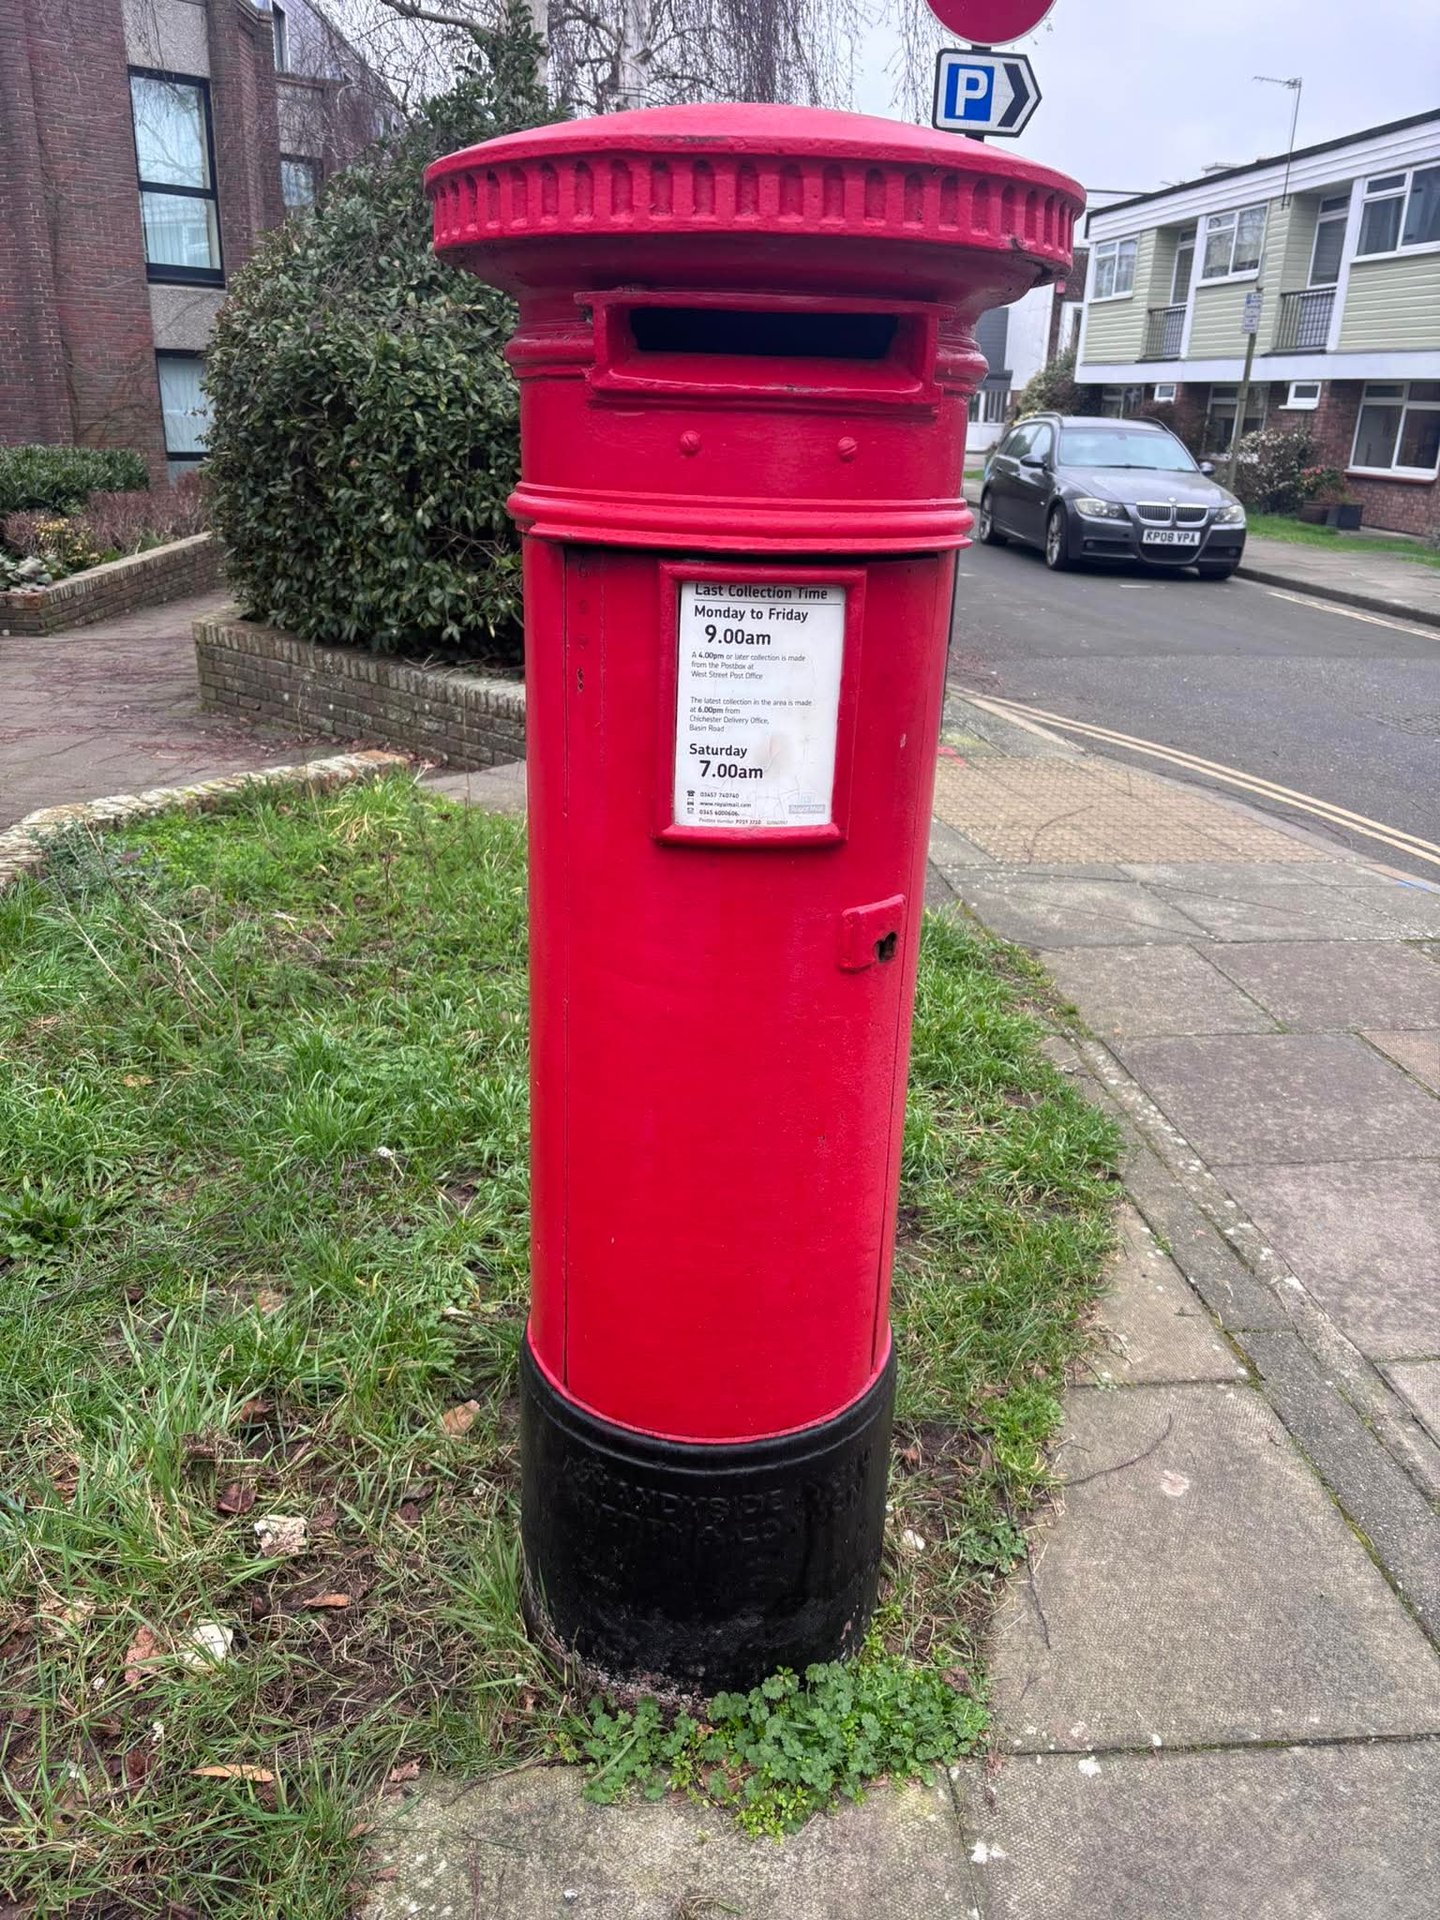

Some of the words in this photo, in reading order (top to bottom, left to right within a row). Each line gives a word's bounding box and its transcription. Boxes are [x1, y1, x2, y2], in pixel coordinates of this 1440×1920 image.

[955, 68, 989, 117] P
[1146, 531, 1174, 543] KP08
[1177, 532, 1196, 543] VPA
[695, 583, 724, 596] Last
[728, 585, 792, 599] Collection
[797, 587, 828, 600] Time
[694, 605, 746, 622] Monday
[750, 608, 764, 620] to
[768, 608, 809, 623] Friday
[705, 624, 771, 645] 9.00am
[698, 652, 725, 660] 4.00pm
[720, 662, 746, 670] Postbox
[708, 671, 728, 679] Street
[745, 672, 763, 680] Office
[690, 696, 702, 704] The
[704, 697, 721, 705] latest
[697, 706, 724, 715] 6.00pm
[690, 715, 722, 723] Chichester
[723, 716, 749, 725] Delivery
[750, 717, 769, 725] Office,
[689, 724, 707, 732] Basin
[689, 743, 748, 759] Saturday
[699, 760, 763, 779] 7.00am
